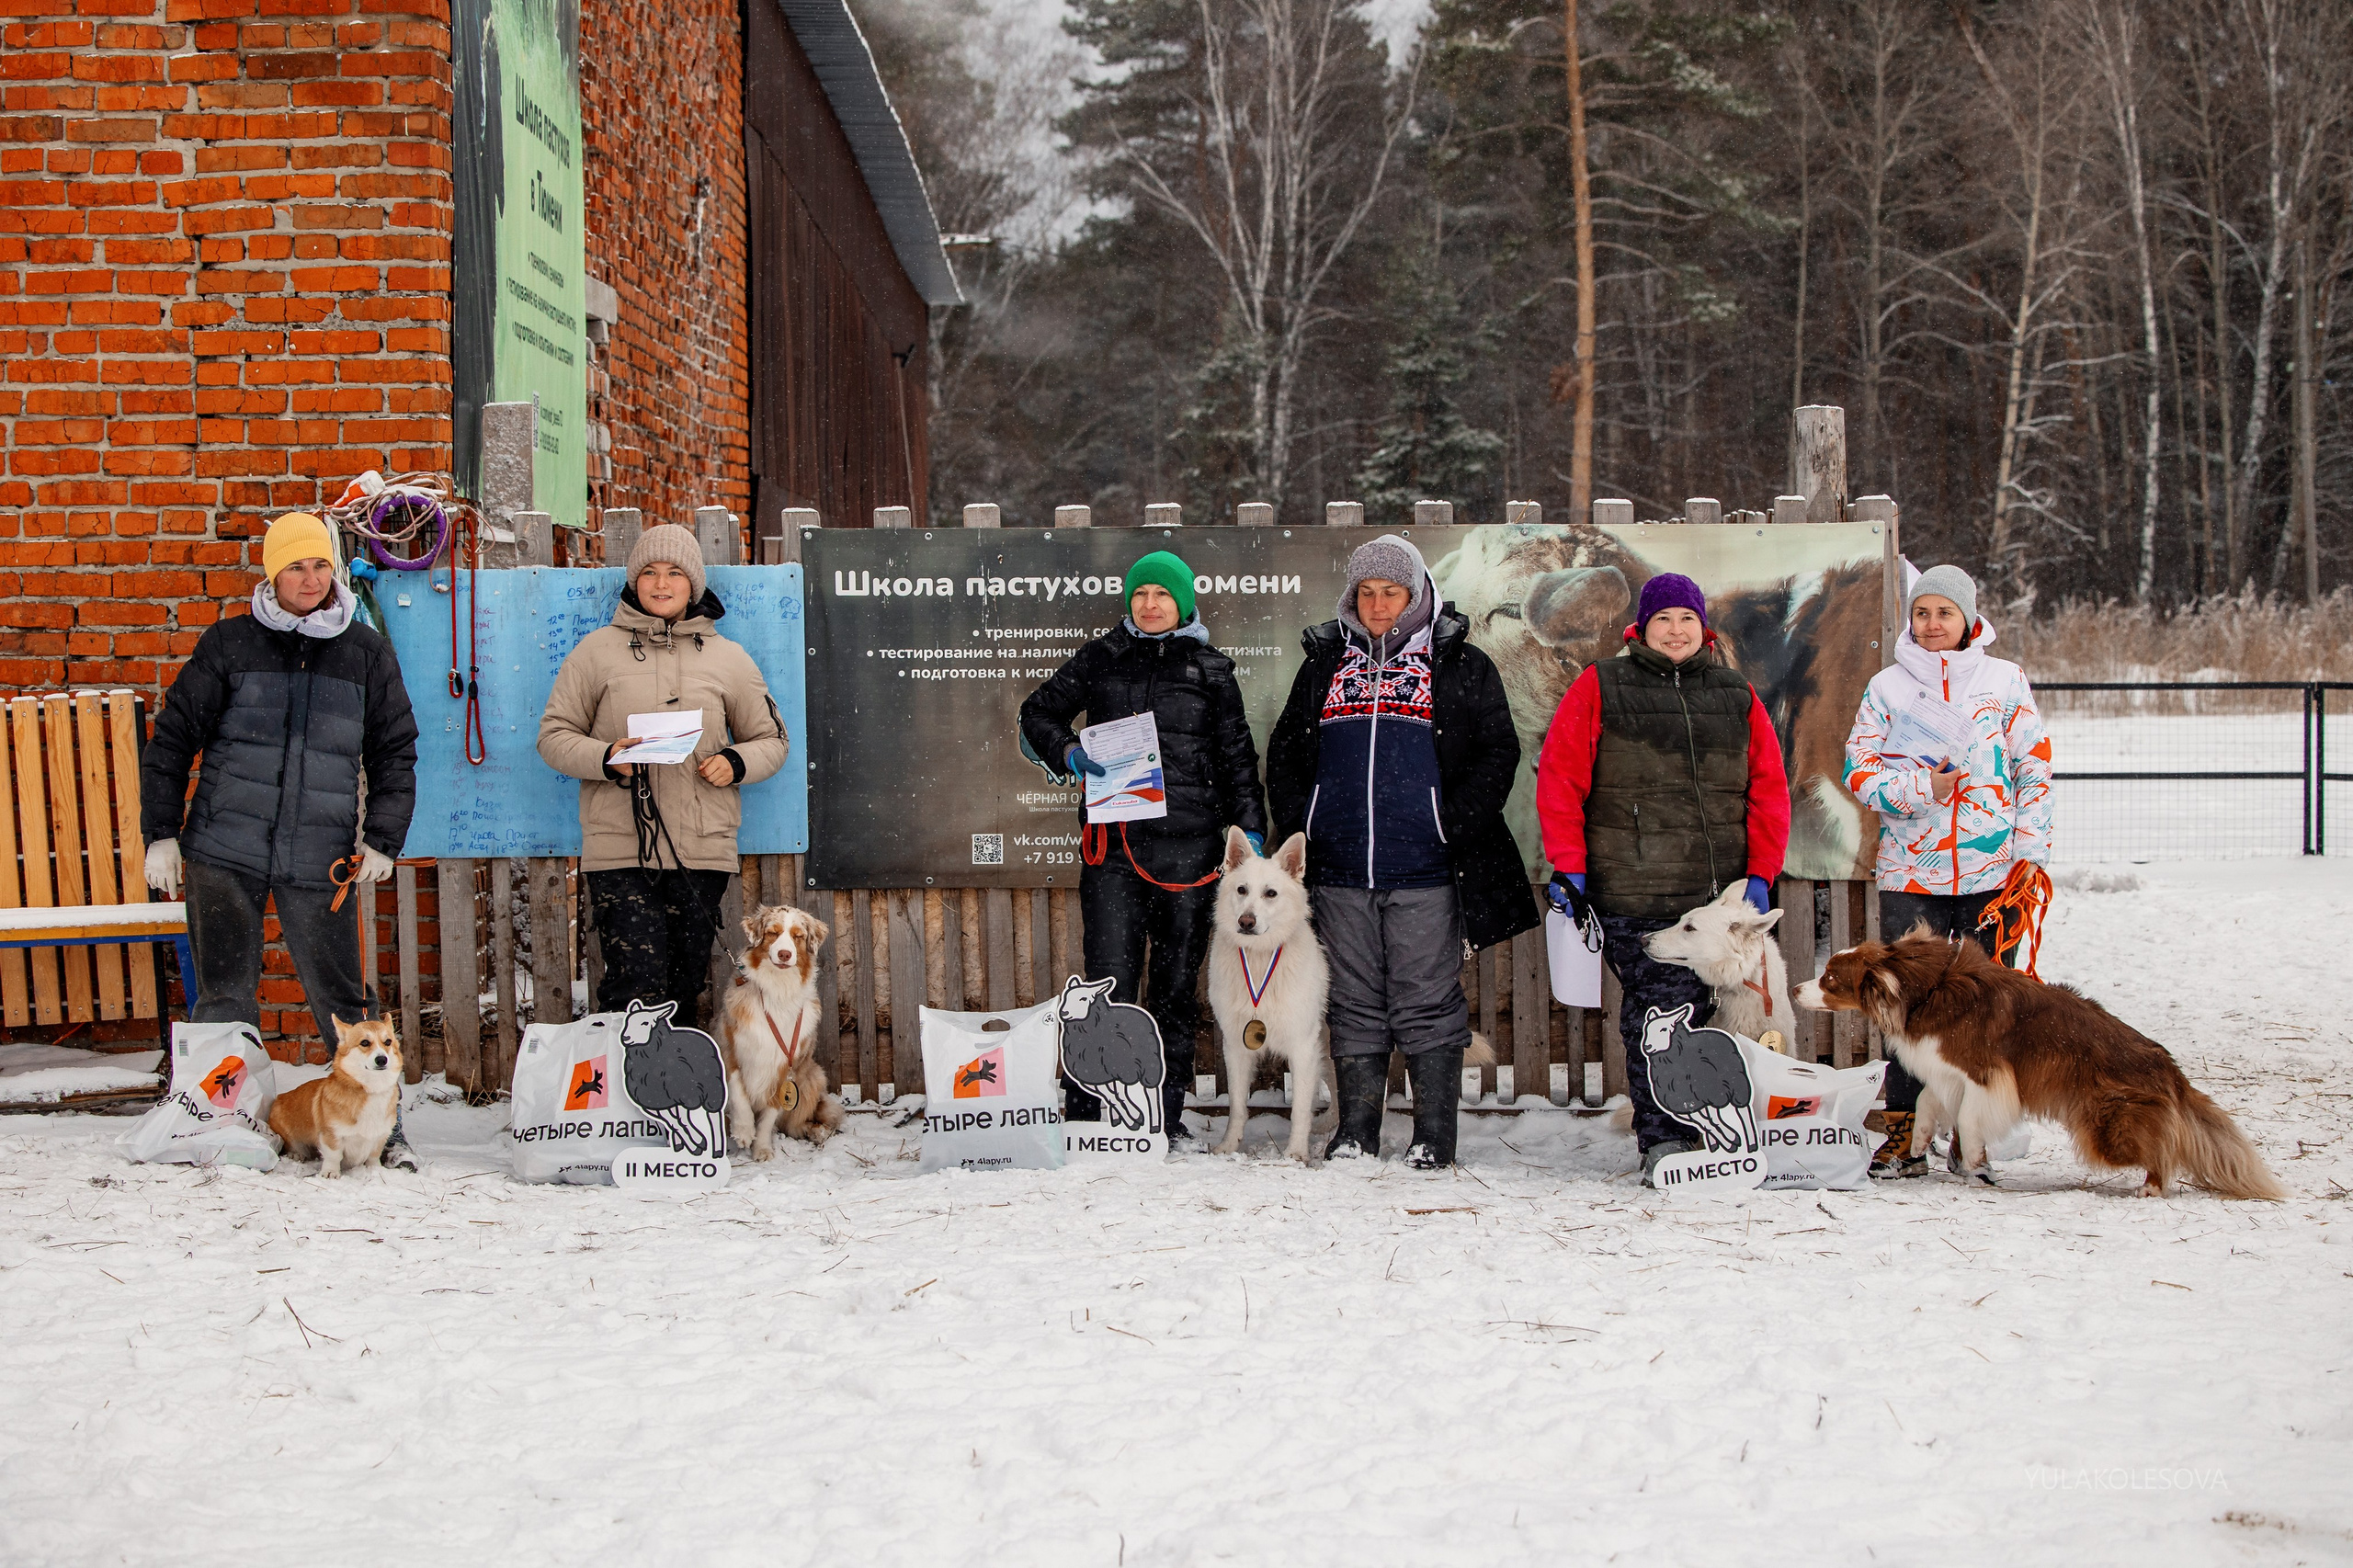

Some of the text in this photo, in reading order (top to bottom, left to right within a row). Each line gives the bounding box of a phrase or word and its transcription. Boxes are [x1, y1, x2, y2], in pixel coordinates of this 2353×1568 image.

[515, 73, 570, 171] Школа пастухов
[530, 169, 563, 234] в Тюмени
[835, 569, 954, 597] Школа
[966, 576, 1123, 602] пастухов
[985, 628, 1088, 641] тренировки,
[879, 648, 994, 662] тестирование
[998, 648, 1021, 659] на
[911, 667, 1006, 680] подготовка
[1011, 669, 1021, 678] к
[1017, 791, 1066, 804] ЧЁРНАЯ
[1023, 852, 1041, 864] +7
[1046, 852, 1074, 864] 919
[156, 1091, 214, 1121] етыре
[922, 1107, 1062, 1133] етыре лапы
[513, 1119, 593, 1143] четыре
[1805, 1127, 1864, 1148] лапы
[1078, 1136, 1152, 1153] МЕСТО
[625, 1162, 718, 1178] II МЕСТО
[976, 1157, 1012, 1166] 4lapy.ru
[1663, 1157, 1758, 1186] III МЕСТО
[1779, 1173, 1815, 1181] 4lapy.ru
